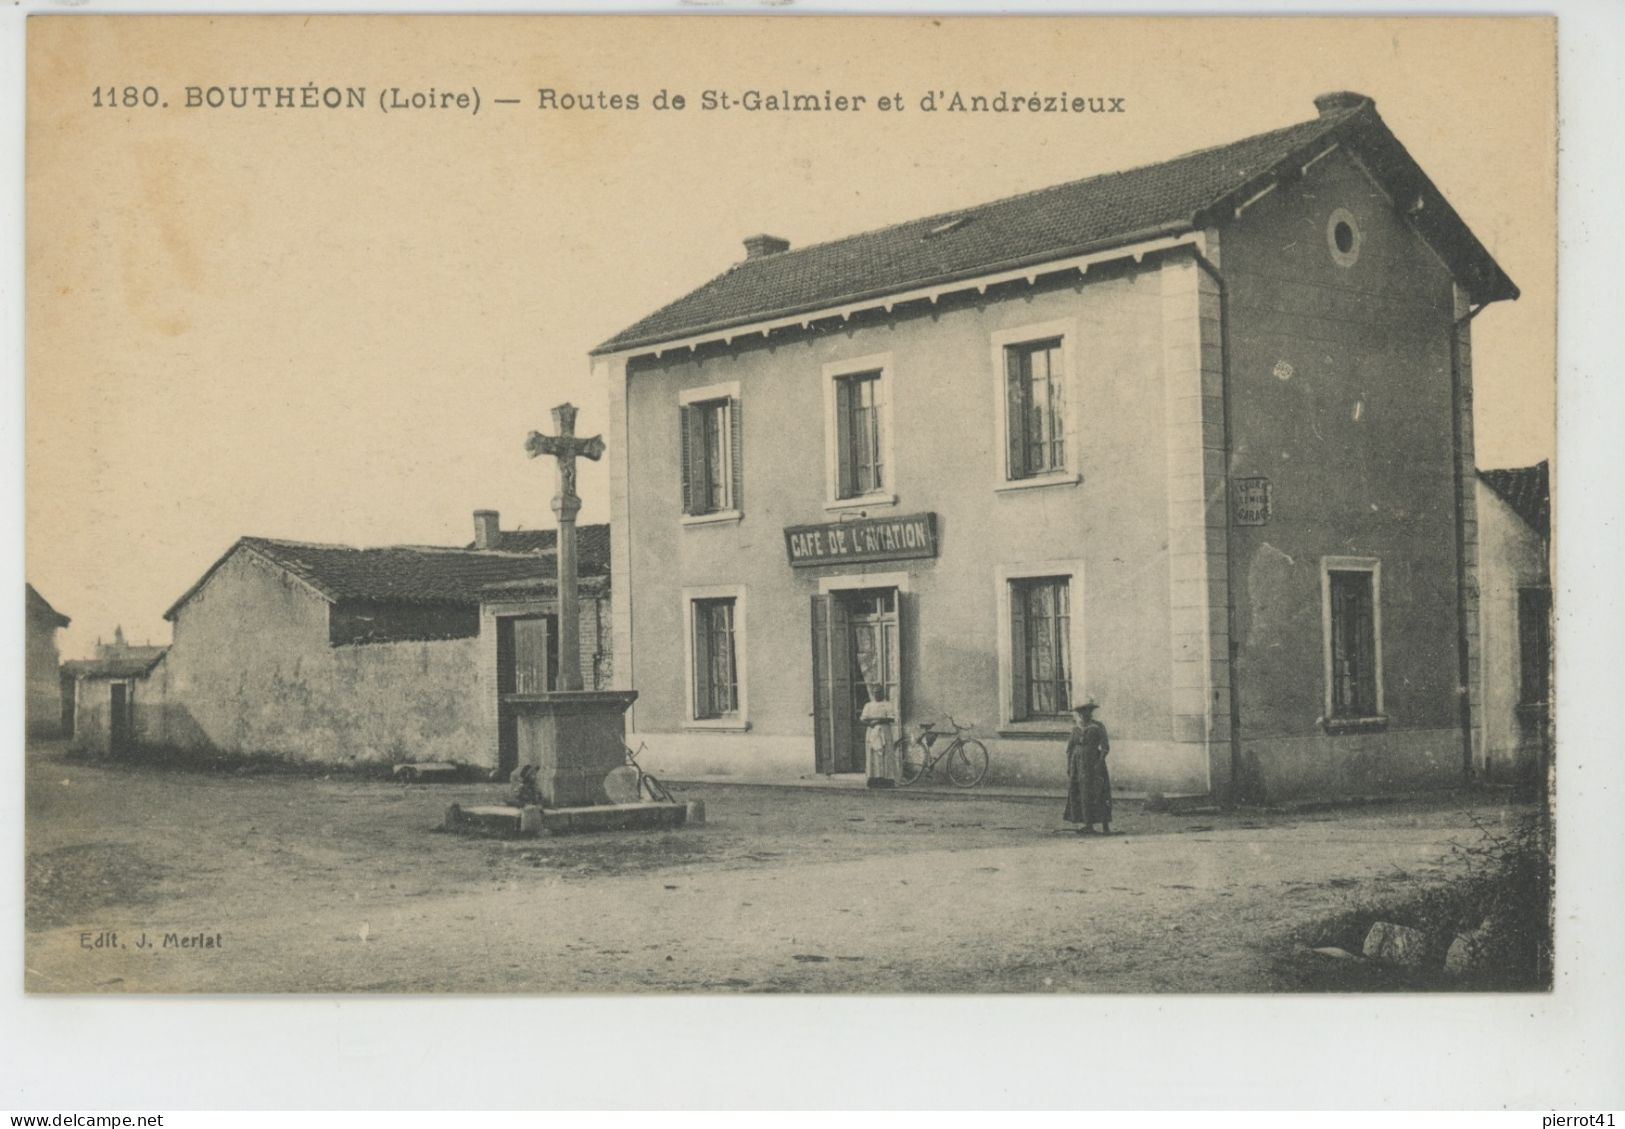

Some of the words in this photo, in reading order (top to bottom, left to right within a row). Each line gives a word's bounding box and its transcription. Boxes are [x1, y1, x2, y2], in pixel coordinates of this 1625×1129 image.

[790, 531, 824, 557] CAFE
[828, 529, 847, 555] DE
[852, 522, 927, 552] L'AVIATION
